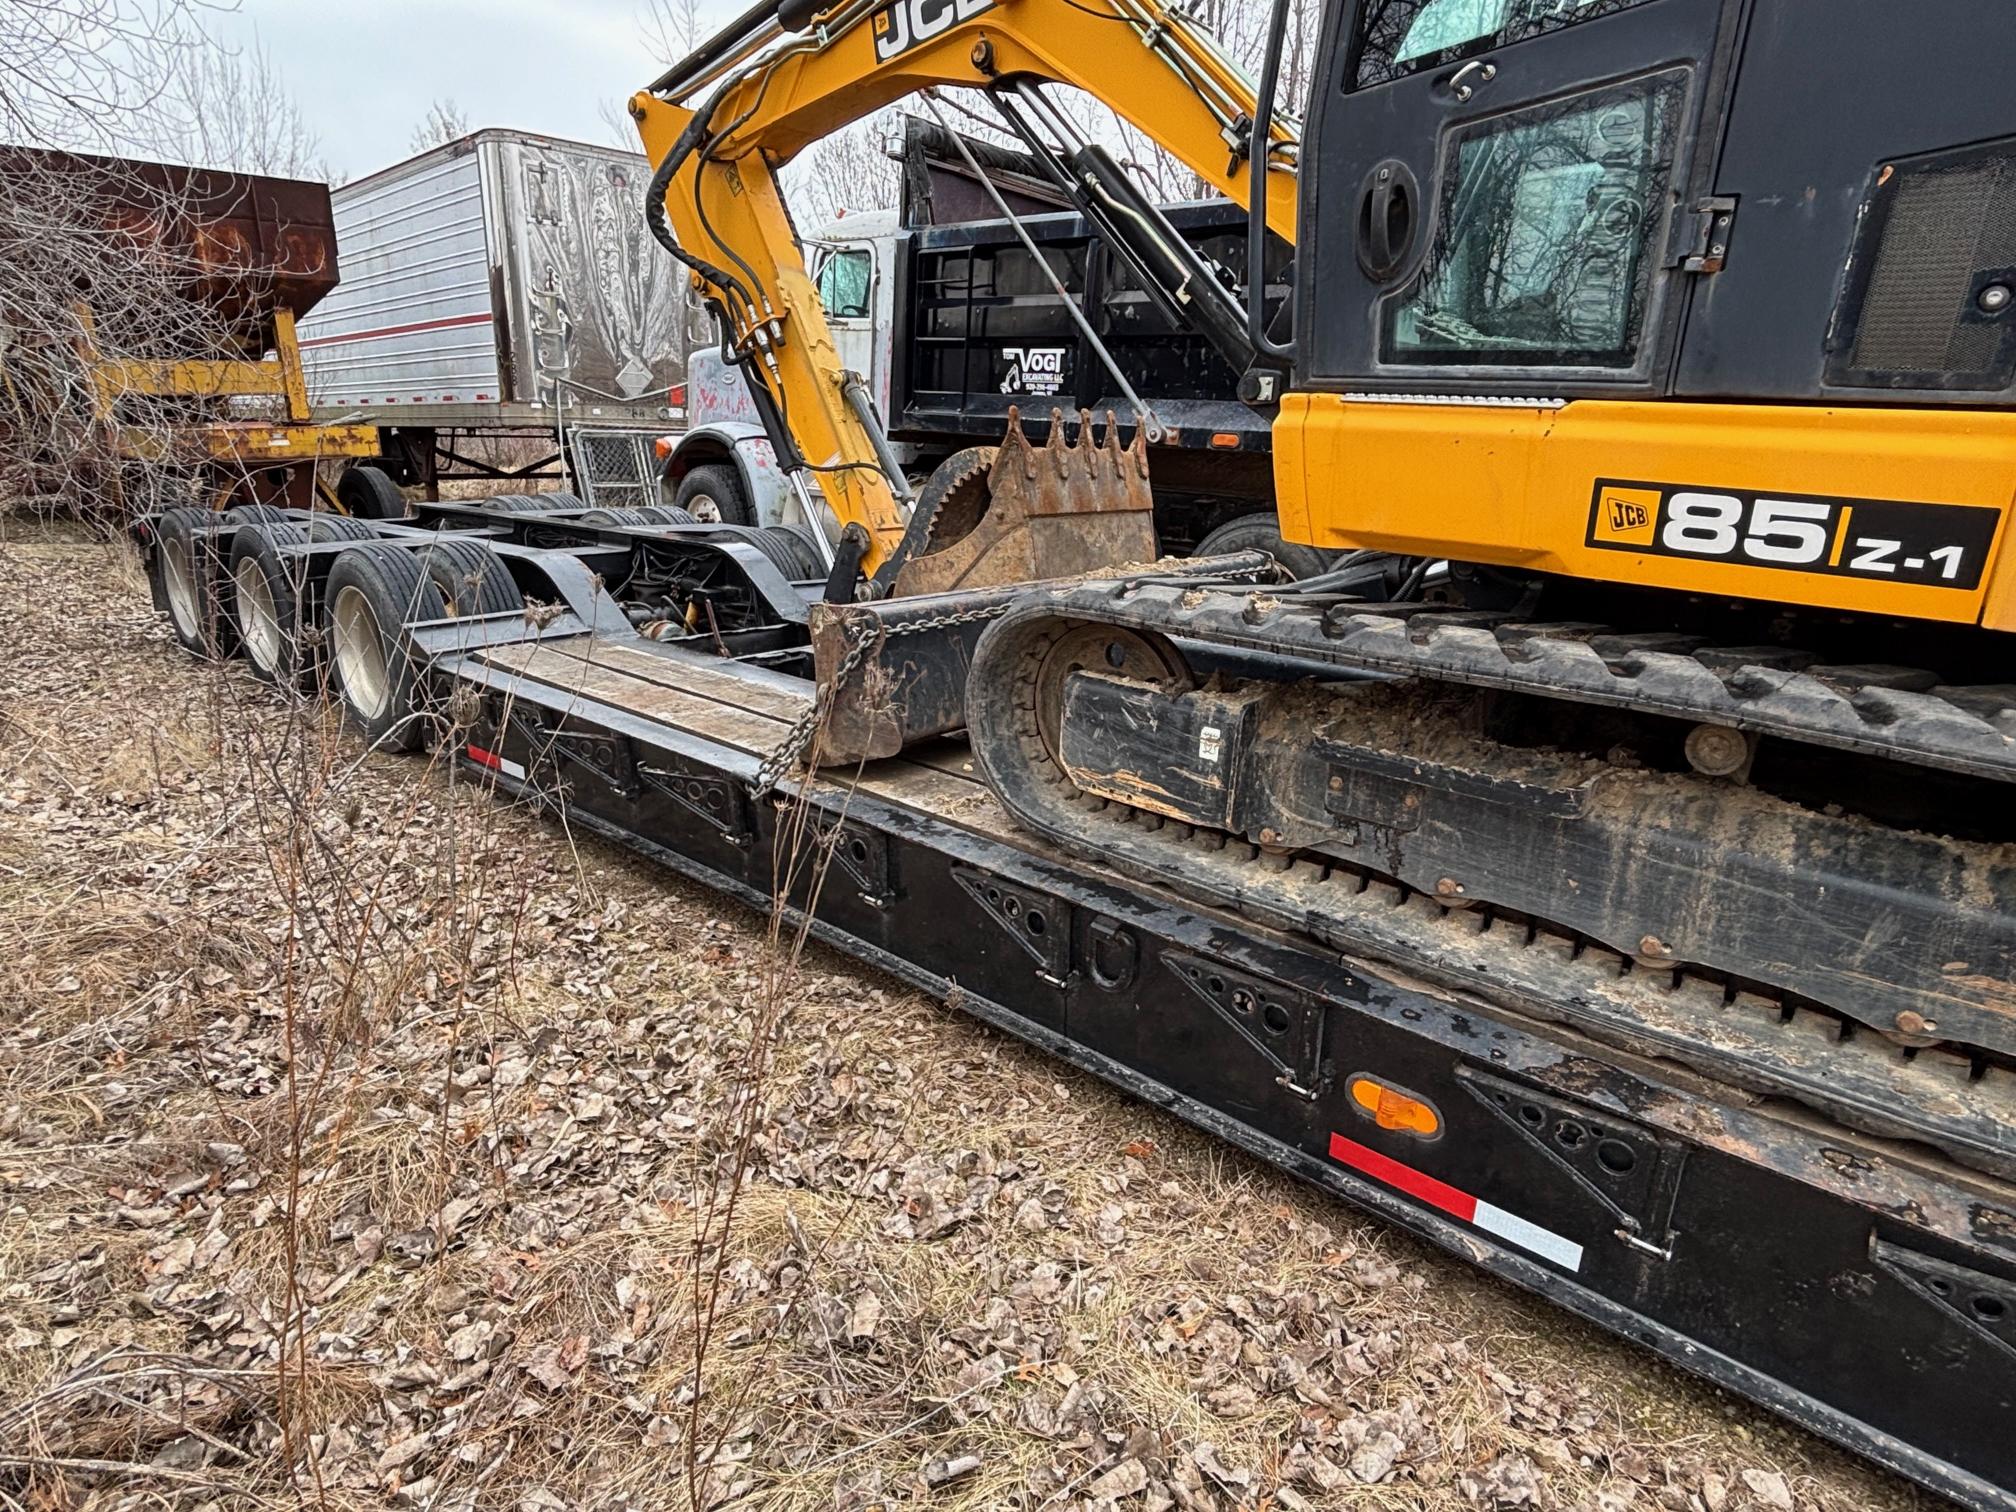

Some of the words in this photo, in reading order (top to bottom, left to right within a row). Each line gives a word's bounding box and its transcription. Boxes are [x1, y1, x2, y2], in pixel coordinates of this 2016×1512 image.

[1003, 348, 1065, 372] VOGT
[1022, 373, 1053, 383] EXCAVATING
[1613, 502, 1646, 528] JCB
[1662, 492, 1831, 564] 85
[1849, 537, 1965, 579] Z-1
